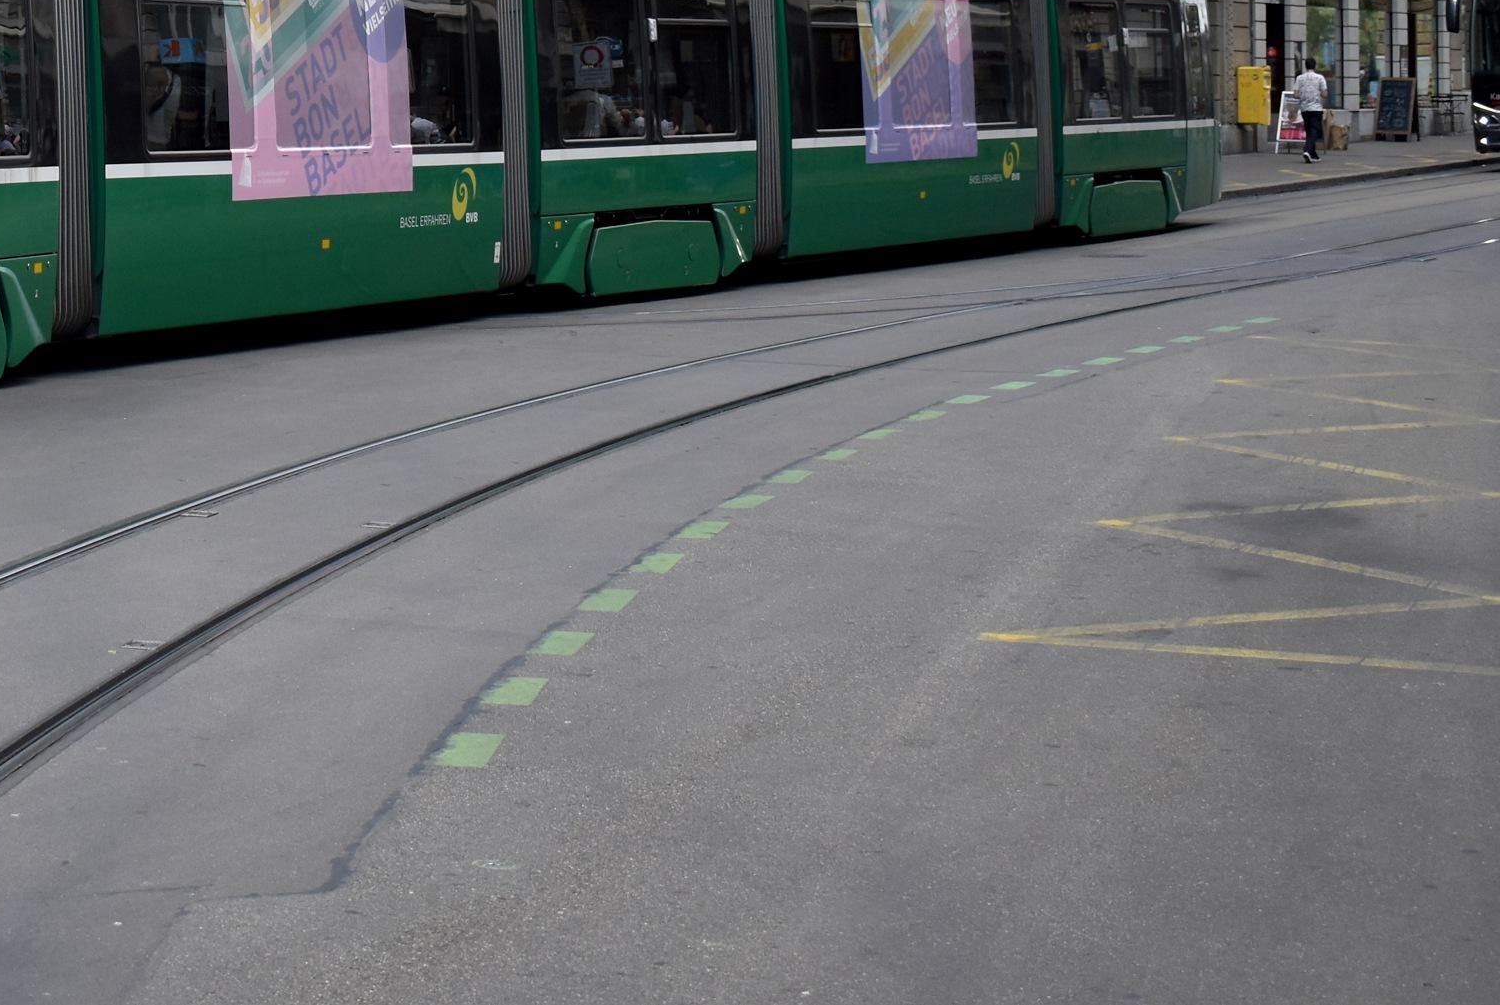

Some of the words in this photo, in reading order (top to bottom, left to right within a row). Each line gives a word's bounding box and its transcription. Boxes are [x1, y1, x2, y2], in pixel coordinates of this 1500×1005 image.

[284, 22, 348, 117] STADT
[896, 39, 937, 103] STADT
[292, 88, 340, 159] BON
[902, 82, 931, 134] BON
[909, 96, 949, 161] BASEL
[303, 107, 372, 197] BASEL
[399, 215, 419, 228] BASEL
[419, 213, 452, 227] ERFAHREN
[465, 211, 478, 224] BVB
